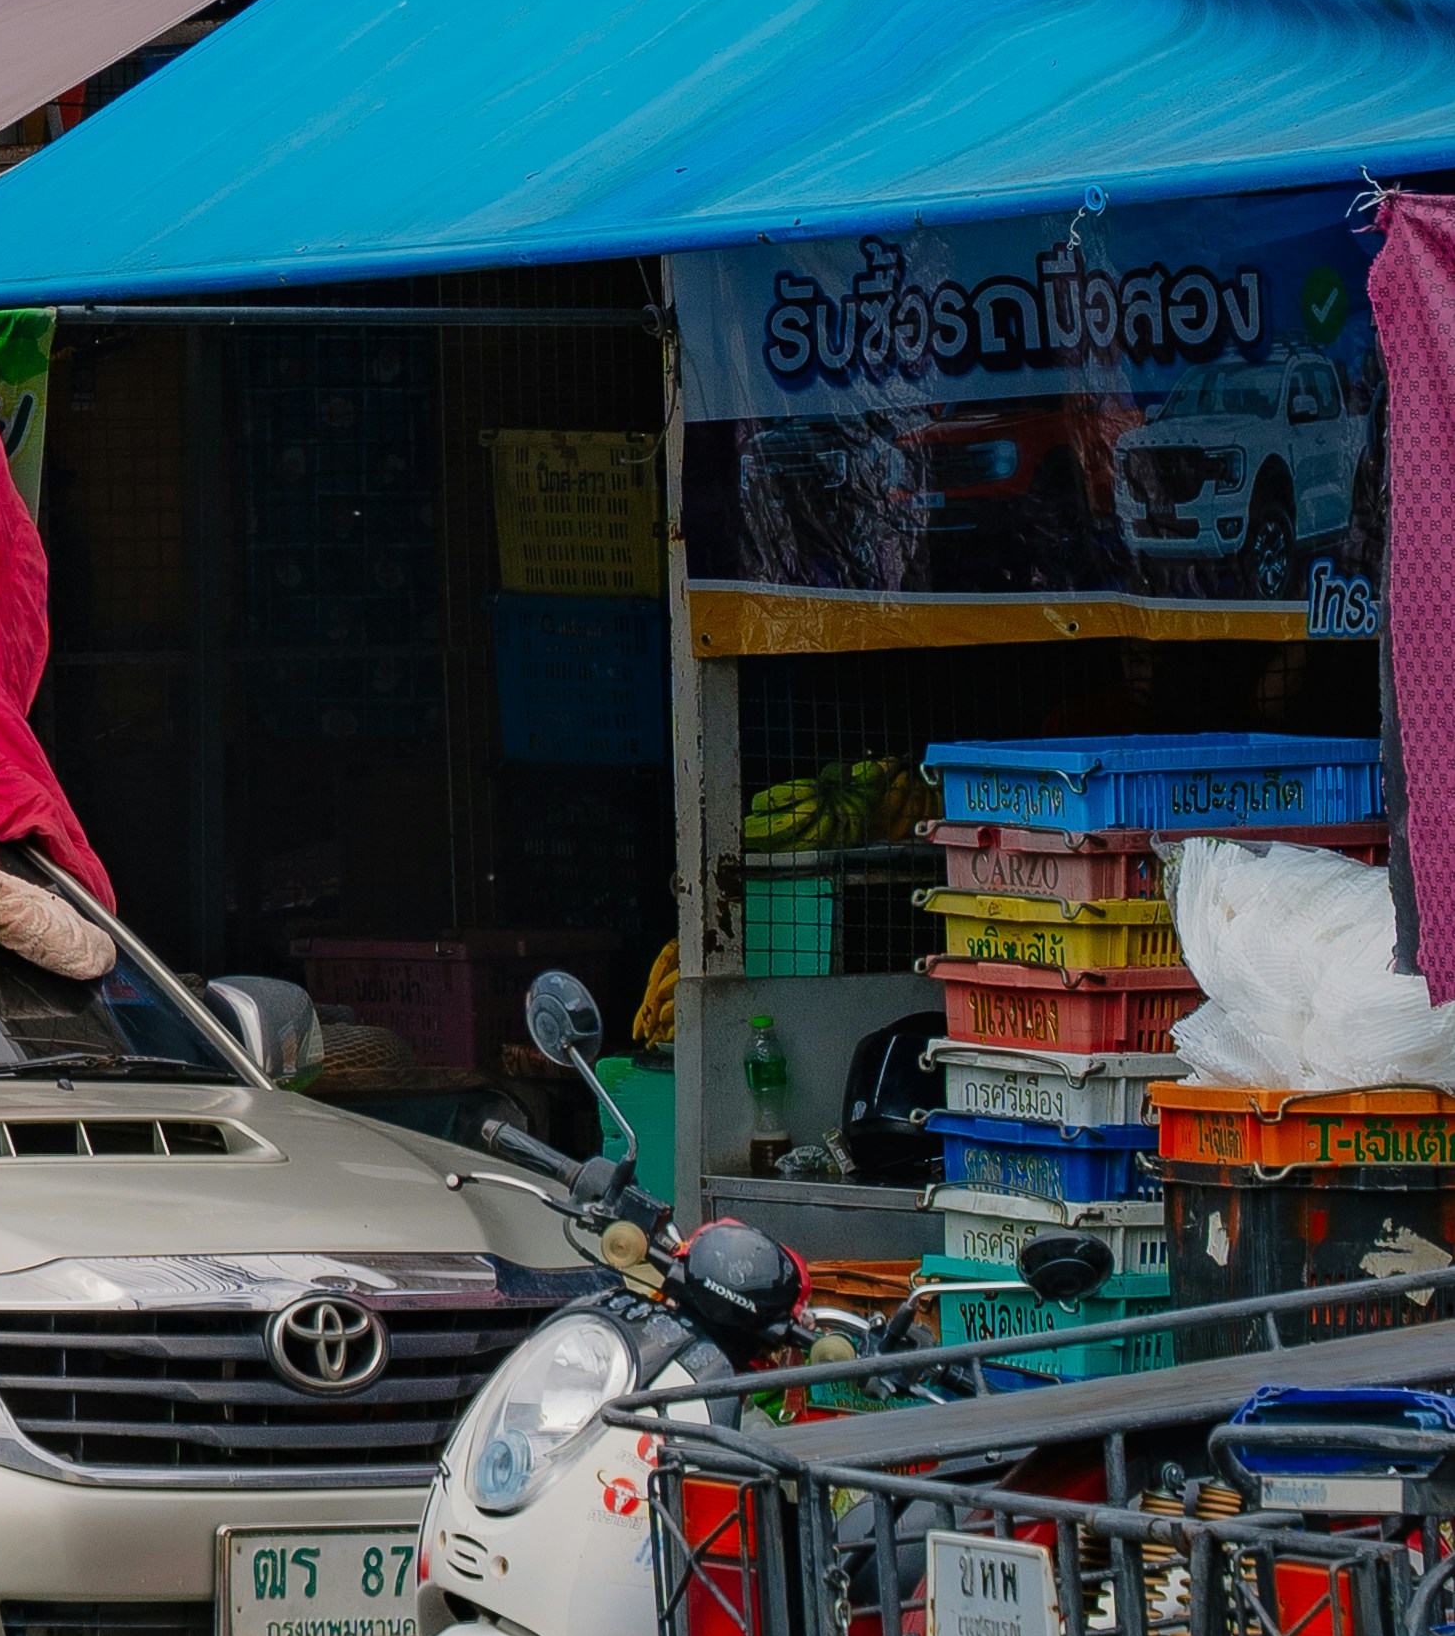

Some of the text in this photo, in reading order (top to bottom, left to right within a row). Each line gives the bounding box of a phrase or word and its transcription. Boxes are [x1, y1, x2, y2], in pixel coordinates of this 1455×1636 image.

[766, 238, 1262, 378] รับซื้อรถมือสอง
[1310, 562, 1375, 633] โทร.
[1172, 766, 1304, 826] แป๊ะภูเก็ต
[971, 852, 1059, 888] CARZO
[1307, 1117, 1455, 1162] T-เจ๊แต๊
[702, 1276, 758, 1314] HONDA
[361, 1545, 415, 1598] 87
